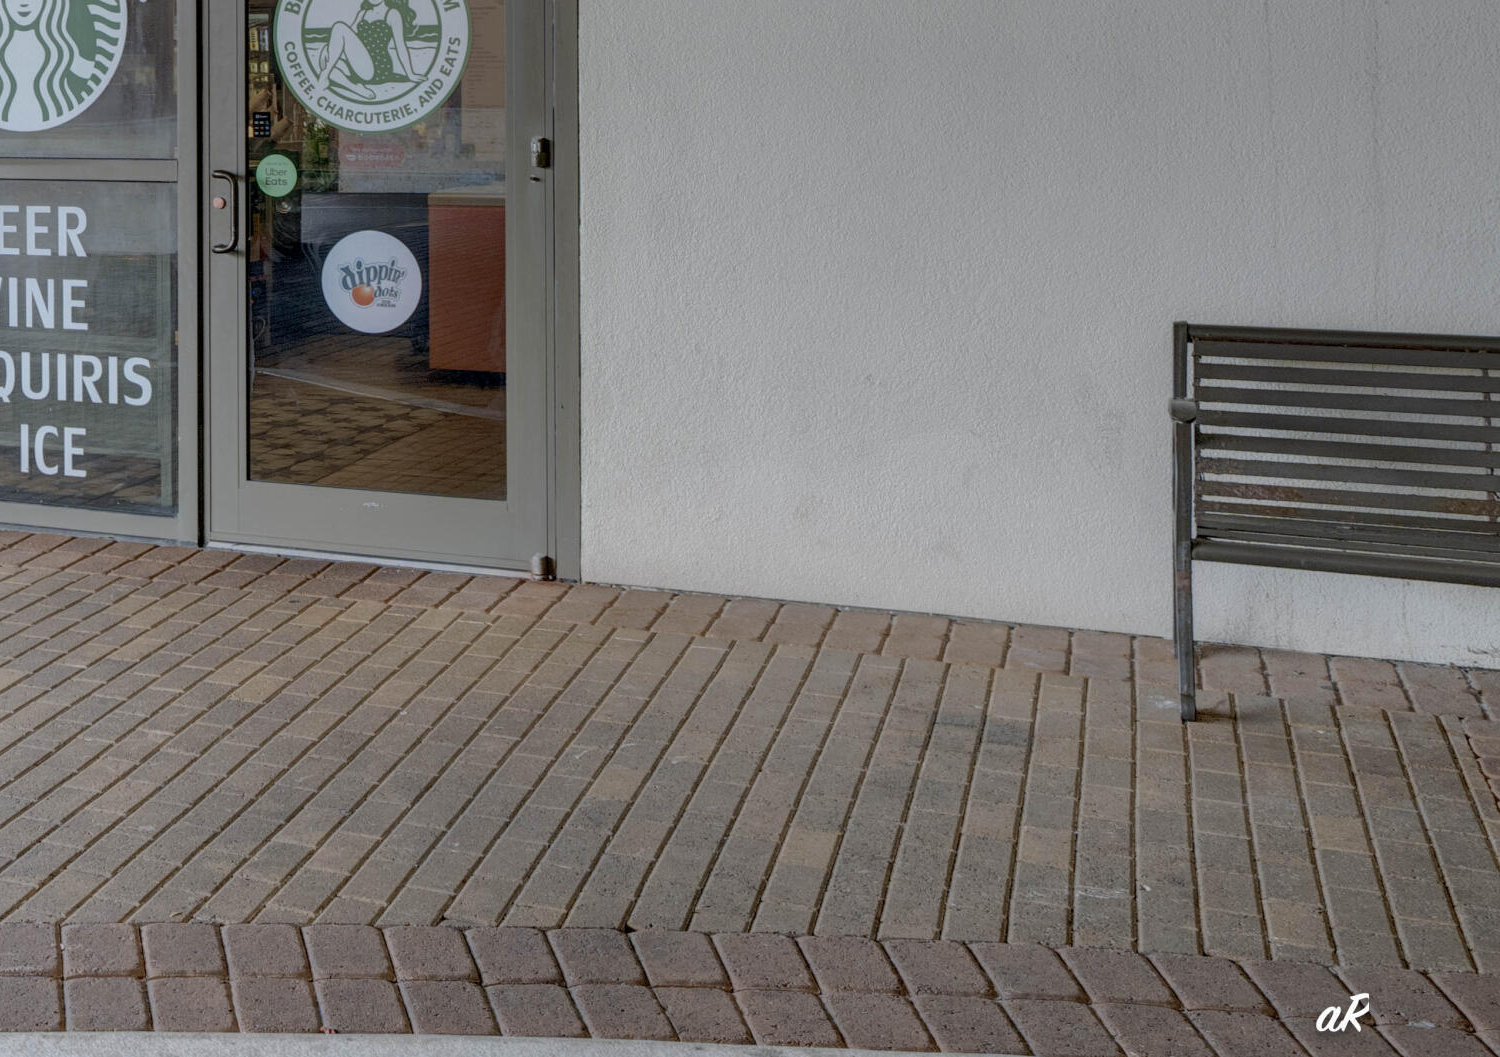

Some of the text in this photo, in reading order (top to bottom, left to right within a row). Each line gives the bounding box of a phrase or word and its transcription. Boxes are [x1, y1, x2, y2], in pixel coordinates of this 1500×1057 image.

[283, 35, 462, 125] COFFEE, CHARCUTERIE, AND EATS
[265, 167, 288, 176] Uber
[265, 176, 288, 186] Eats
[374, 285, 399, 298] dots
[19, 423, 88, 478] ICE
